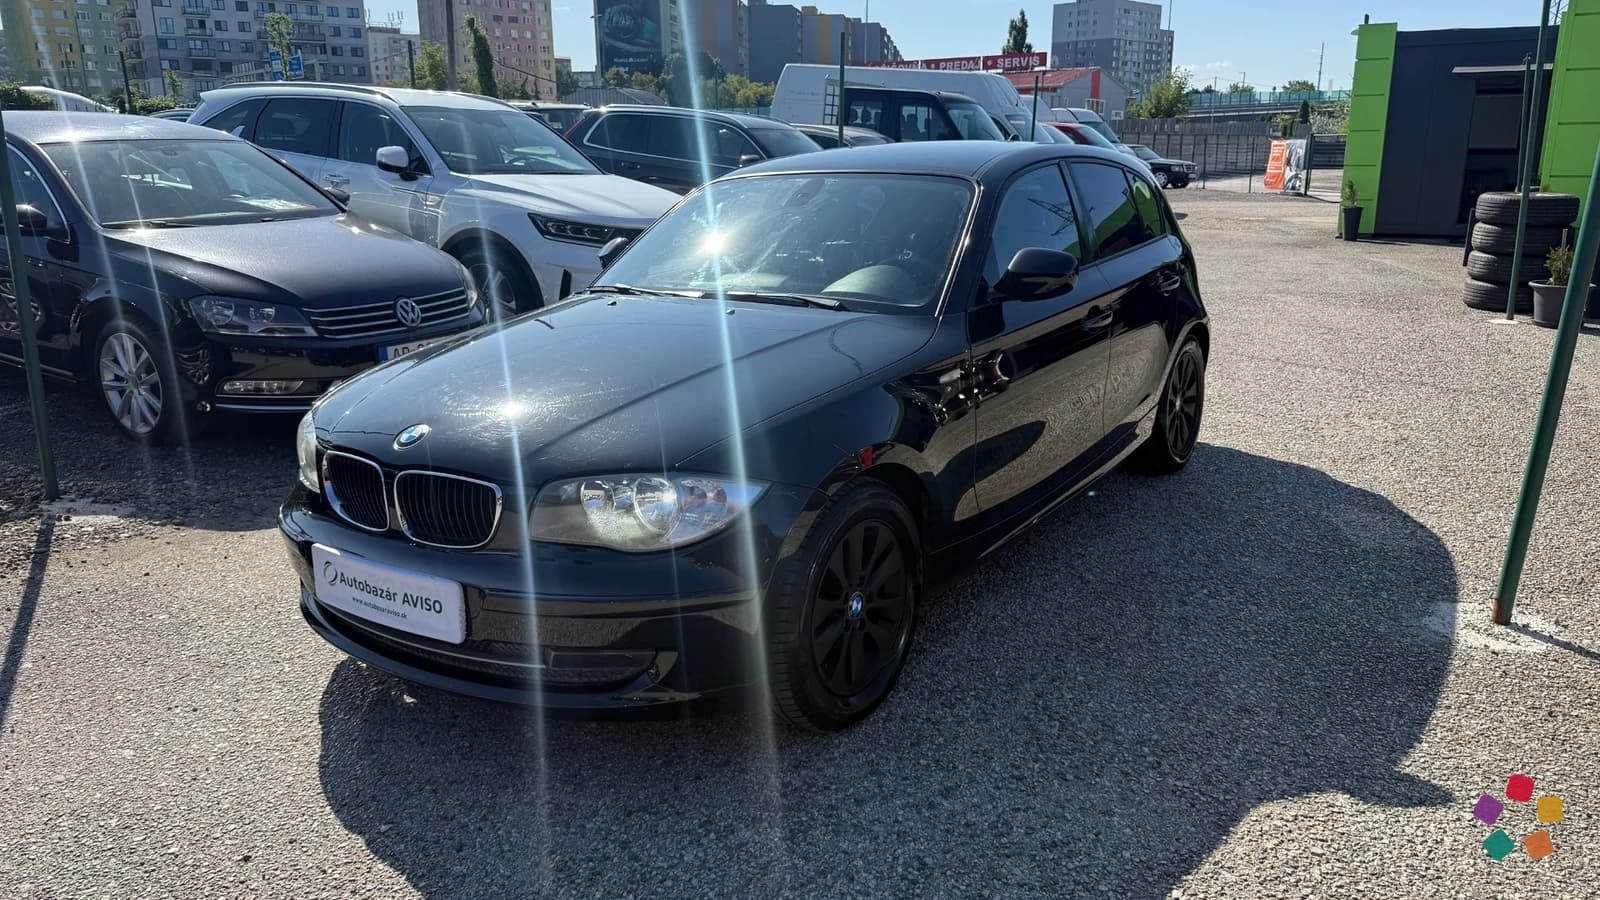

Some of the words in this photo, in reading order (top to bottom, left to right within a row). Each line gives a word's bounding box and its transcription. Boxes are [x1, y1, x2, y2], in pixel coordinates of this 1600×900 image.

[996, 56, 1040, 68] SERVIS
[340, 572, 398, 602] Autobazár
[402, 591, 443, 614] AVISO
